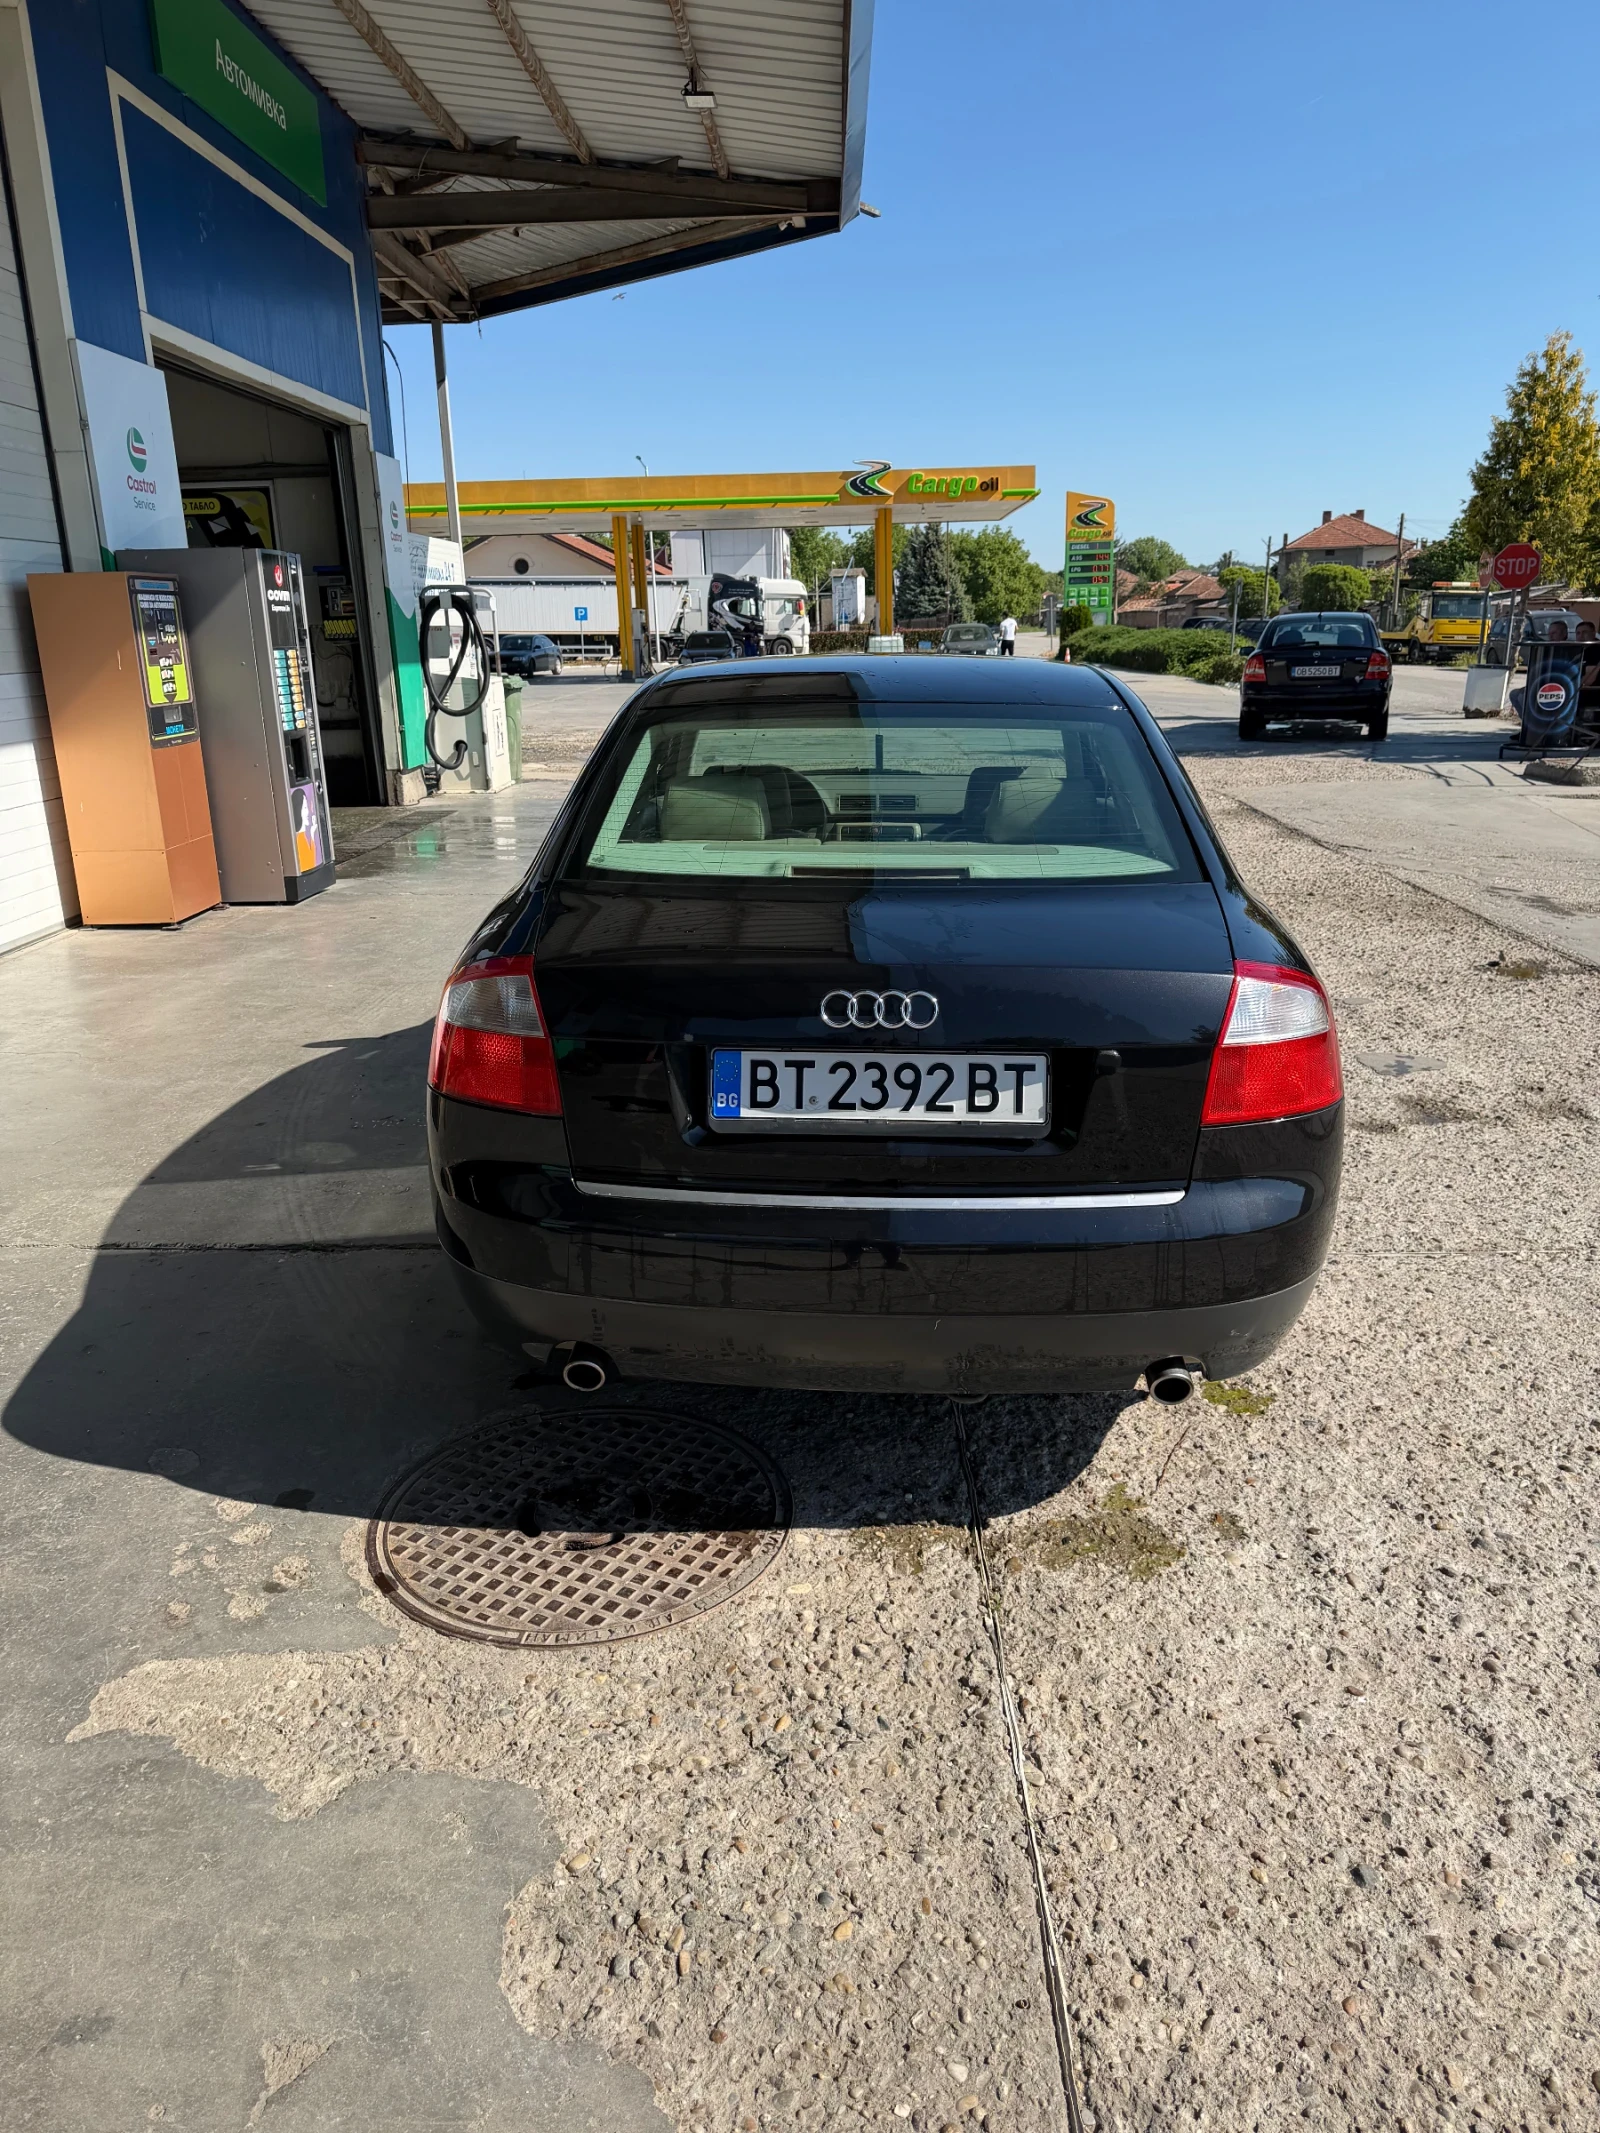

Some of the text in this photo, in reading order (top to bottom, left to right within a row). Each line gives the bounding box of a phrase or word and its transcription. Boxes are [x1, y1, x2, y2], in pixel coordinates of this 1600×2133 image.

[215, 38, 287, 131] Автомивка
[126, 474, 157, 495] Castrol
[907, 471, 999, 499] Cargo oil
[133, 496, 157, 511] Service
[189, 502, 216, 511] ТАБЛО
[1068, 527, 1102, 540] Cargo
[1496, 557, 1538, 576] STOP
[578, 608, 585, 619] P
[1308, 667, 1327, 676] 5250
[1327, 666, 1338, 675] BT
[1538, 693, 1564, 701] PEPSI
[750, 1059, 1037, 1116] BT 2392 BT
[716, 1092, 739, 1108] BG
